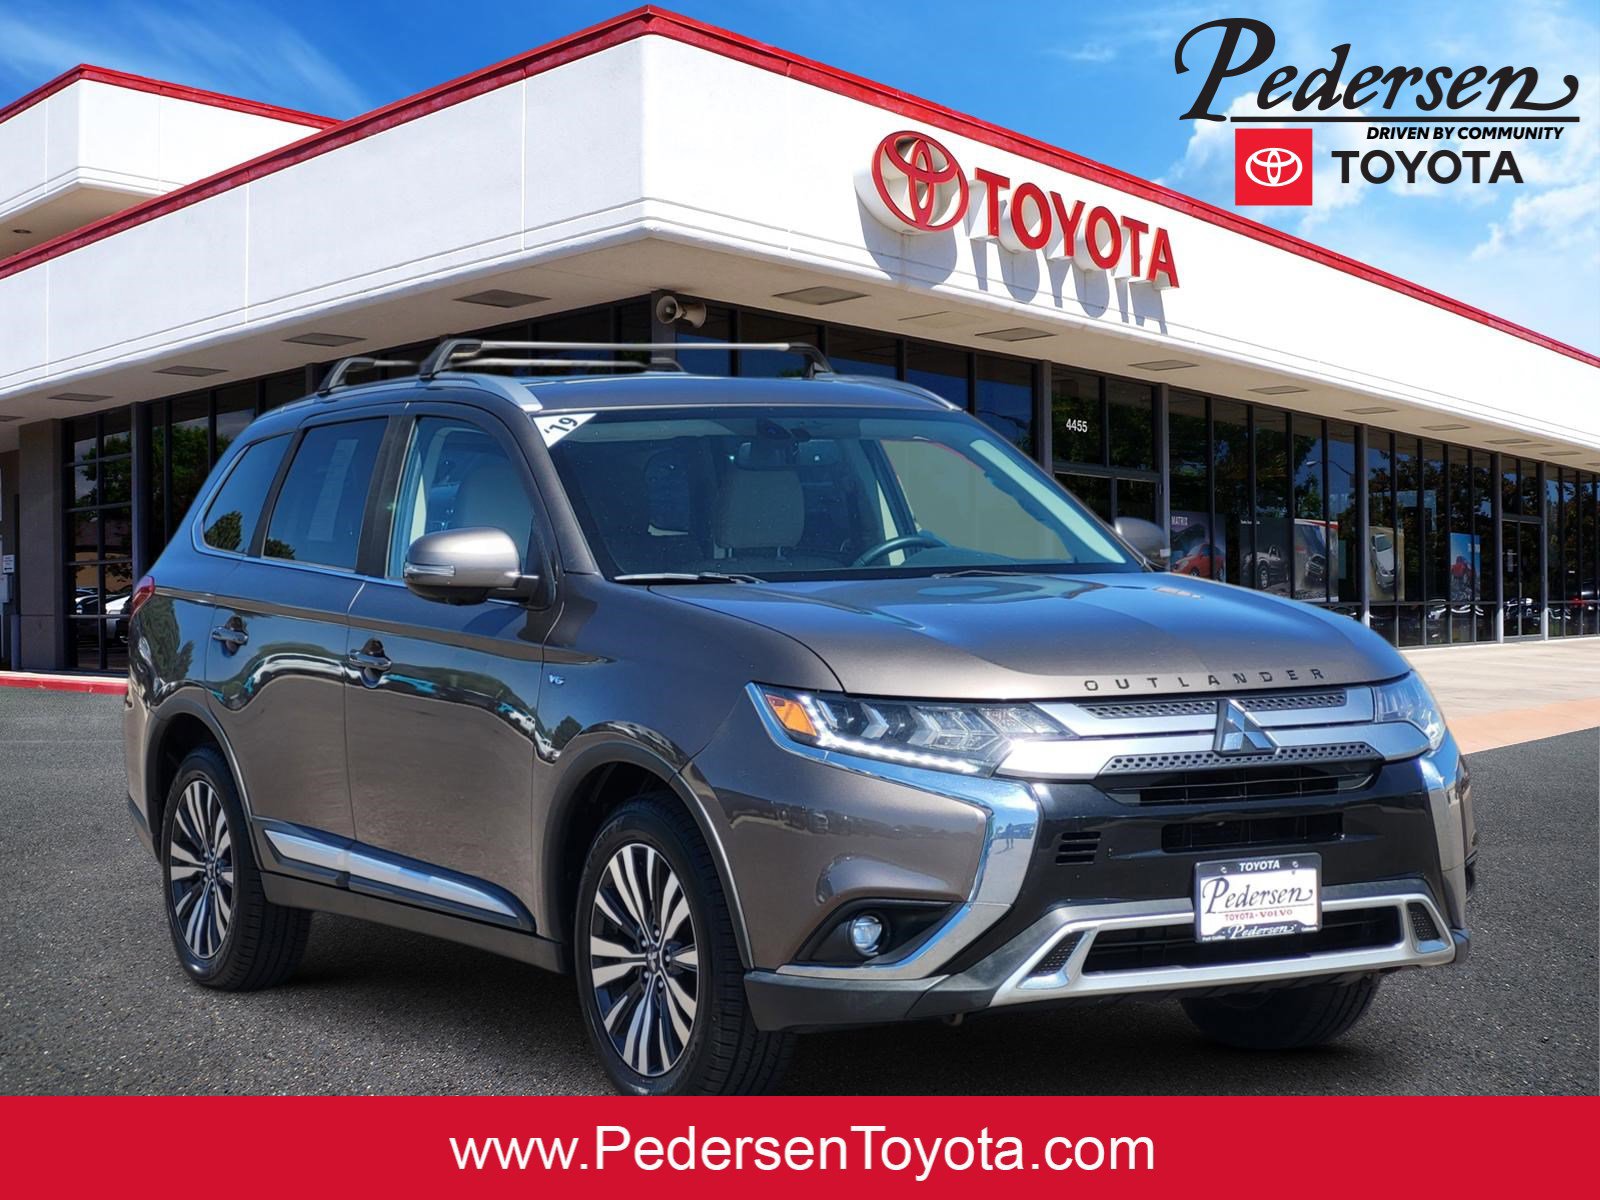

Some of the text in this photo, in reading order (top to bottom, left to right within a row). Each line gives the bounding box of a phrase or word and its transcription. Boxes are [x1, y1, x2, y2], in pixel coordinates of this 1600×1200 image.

[974, 167, 1180, 289] TOYOTA
[1065, 418, 1088, 433] 4455
[1171, 515, 1189, 527] MATRIX
[1084, 668, 1325, 692] OUTLANDER
[1239, 859, 1280, 872] TOYOTA
[1202, 877, 1313, 914] Pedersen
[1225, 913, 1254, 921] TOYOTA
